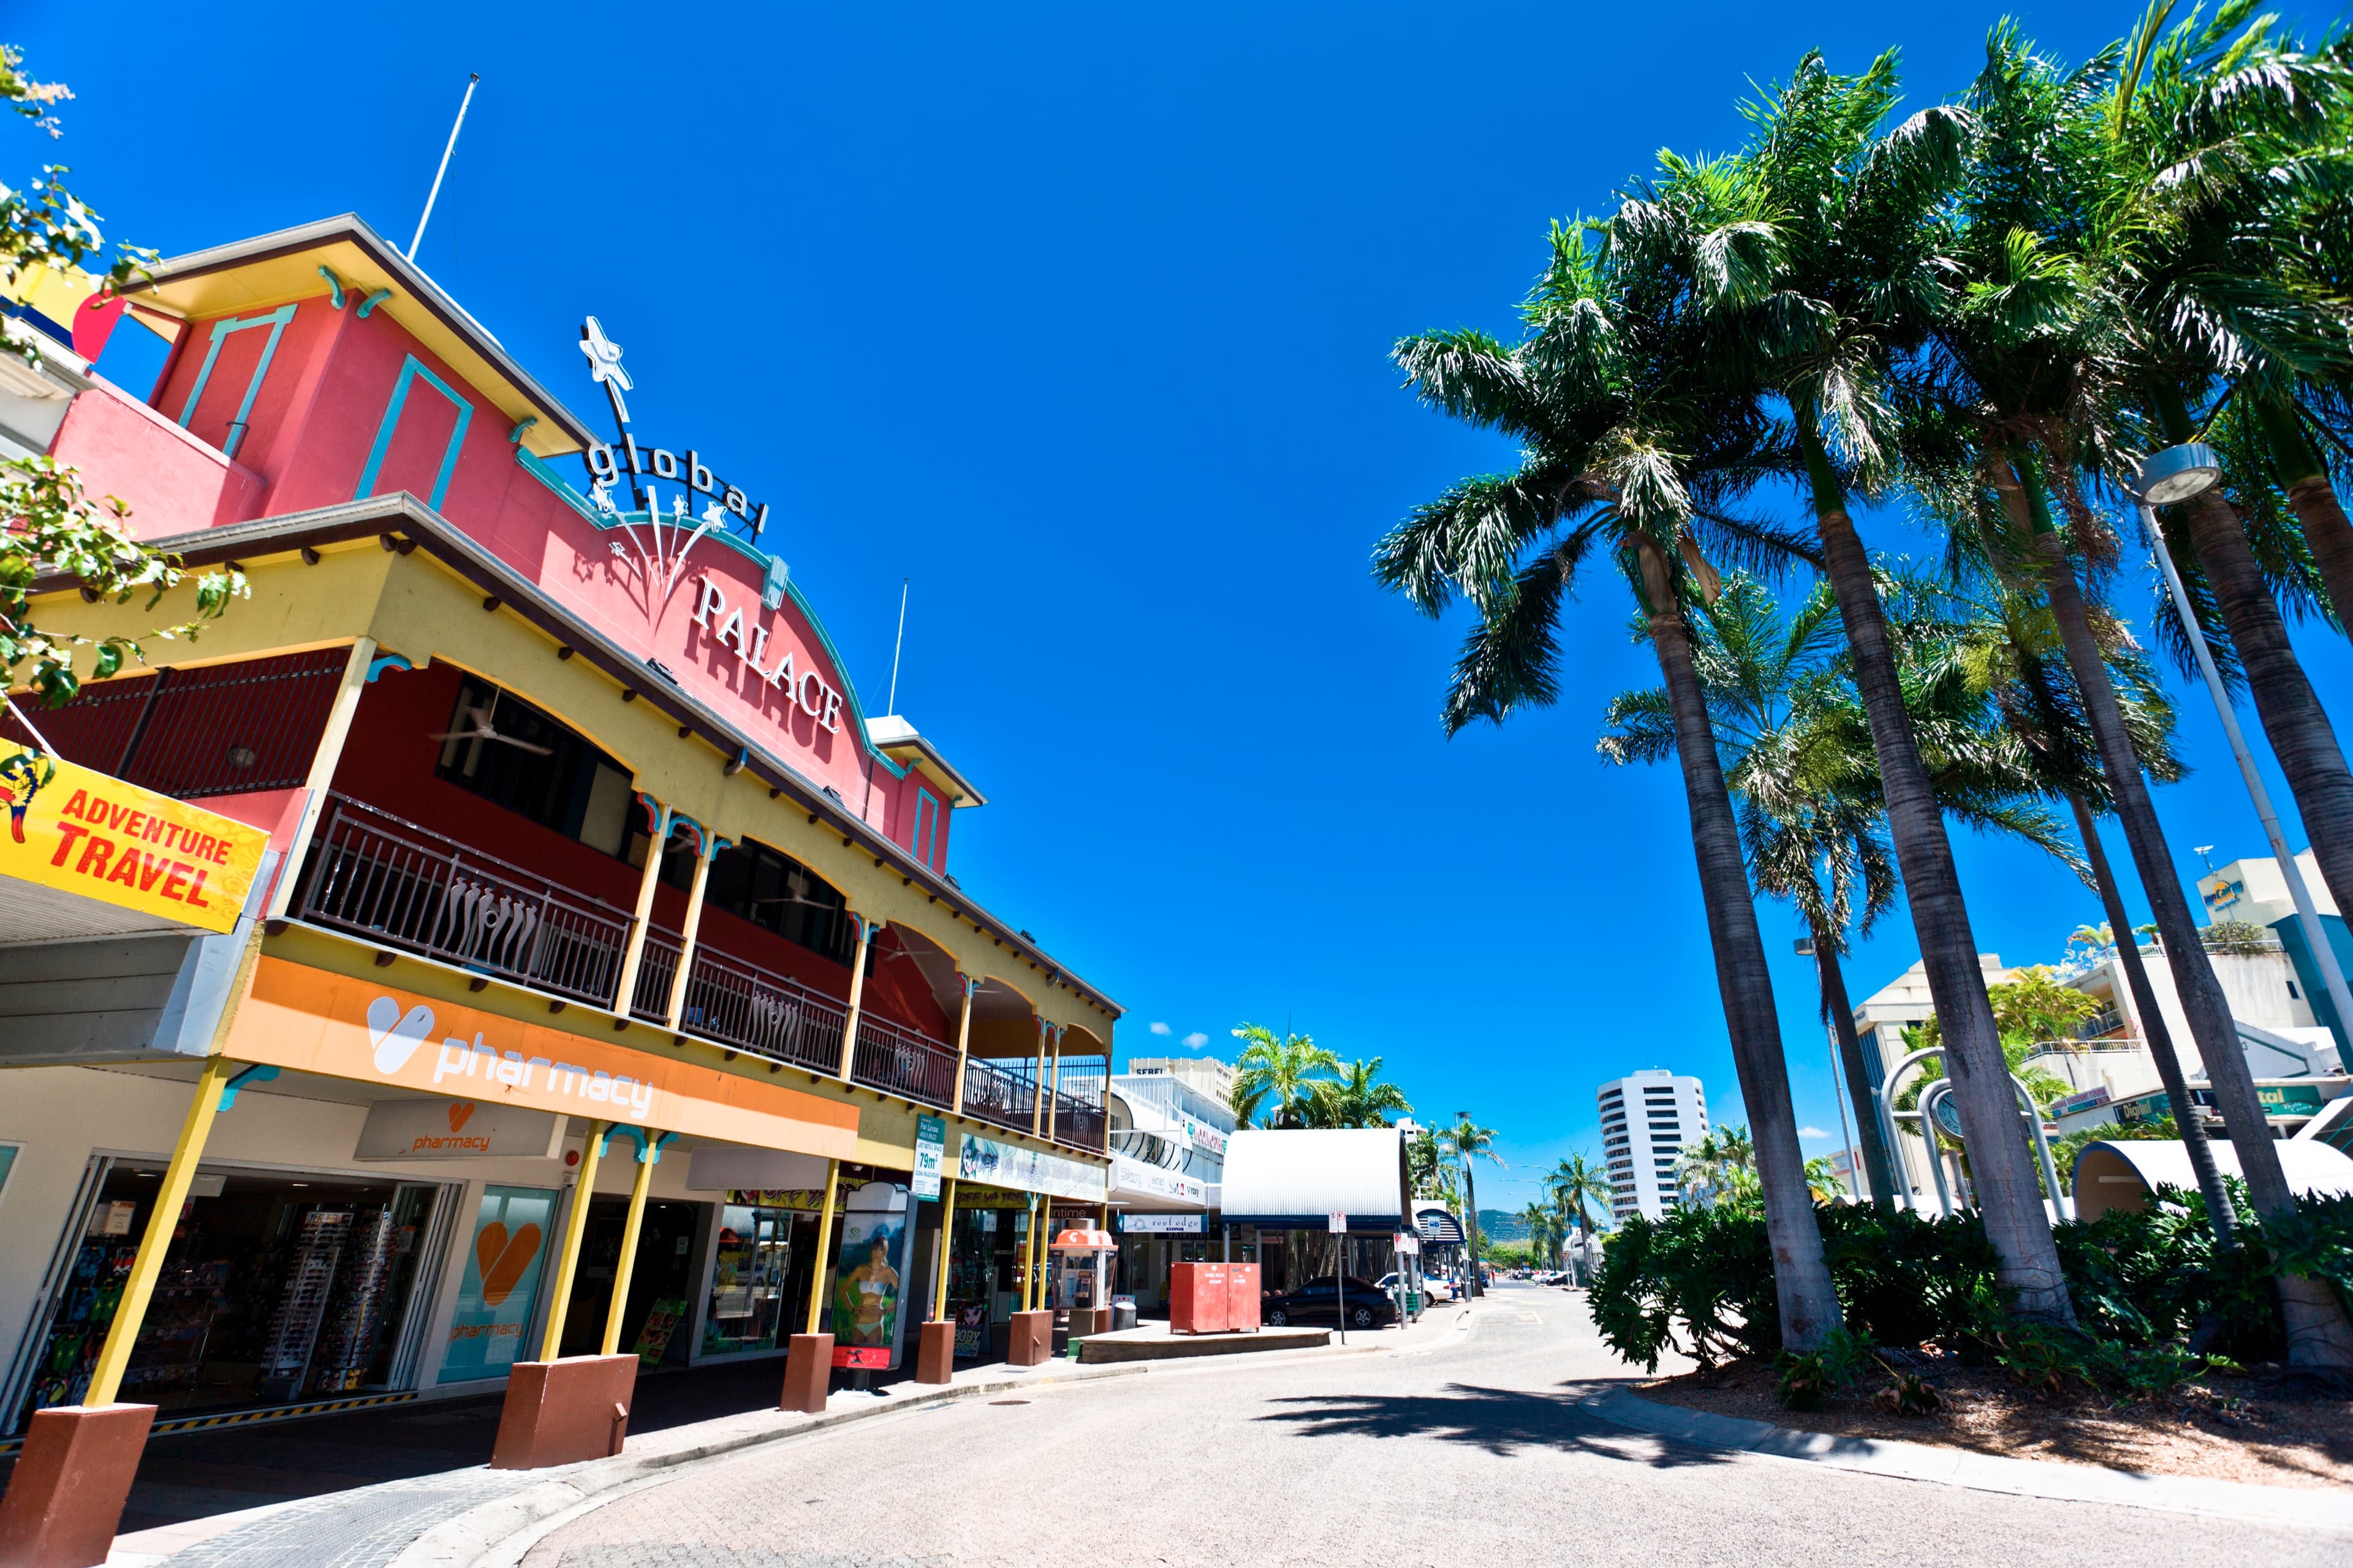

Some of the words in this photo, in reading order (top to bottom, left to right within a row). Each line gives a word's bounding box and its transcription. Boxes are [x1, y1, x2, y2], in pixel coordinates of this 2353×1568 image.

[585, 433, 769, 535] global
[692, 575, 843, 735] PALACE
[62, 789, 233, 866] ADVENTURE
[51, 823, 210, 908] TRAVEL
[433, 1031, 653, 1119] pharmacy
[2123, 1099, 2152, 1120] Digital
[412, 1134, 491, 1153] pharmacy
[1050, 1208, 1086, 1218] intime
[1153, 1216, 1172, 1226] reef
[1176, 1216, 1199, 1228] edge
[449, 1323, 525, 1343] pharmacy
